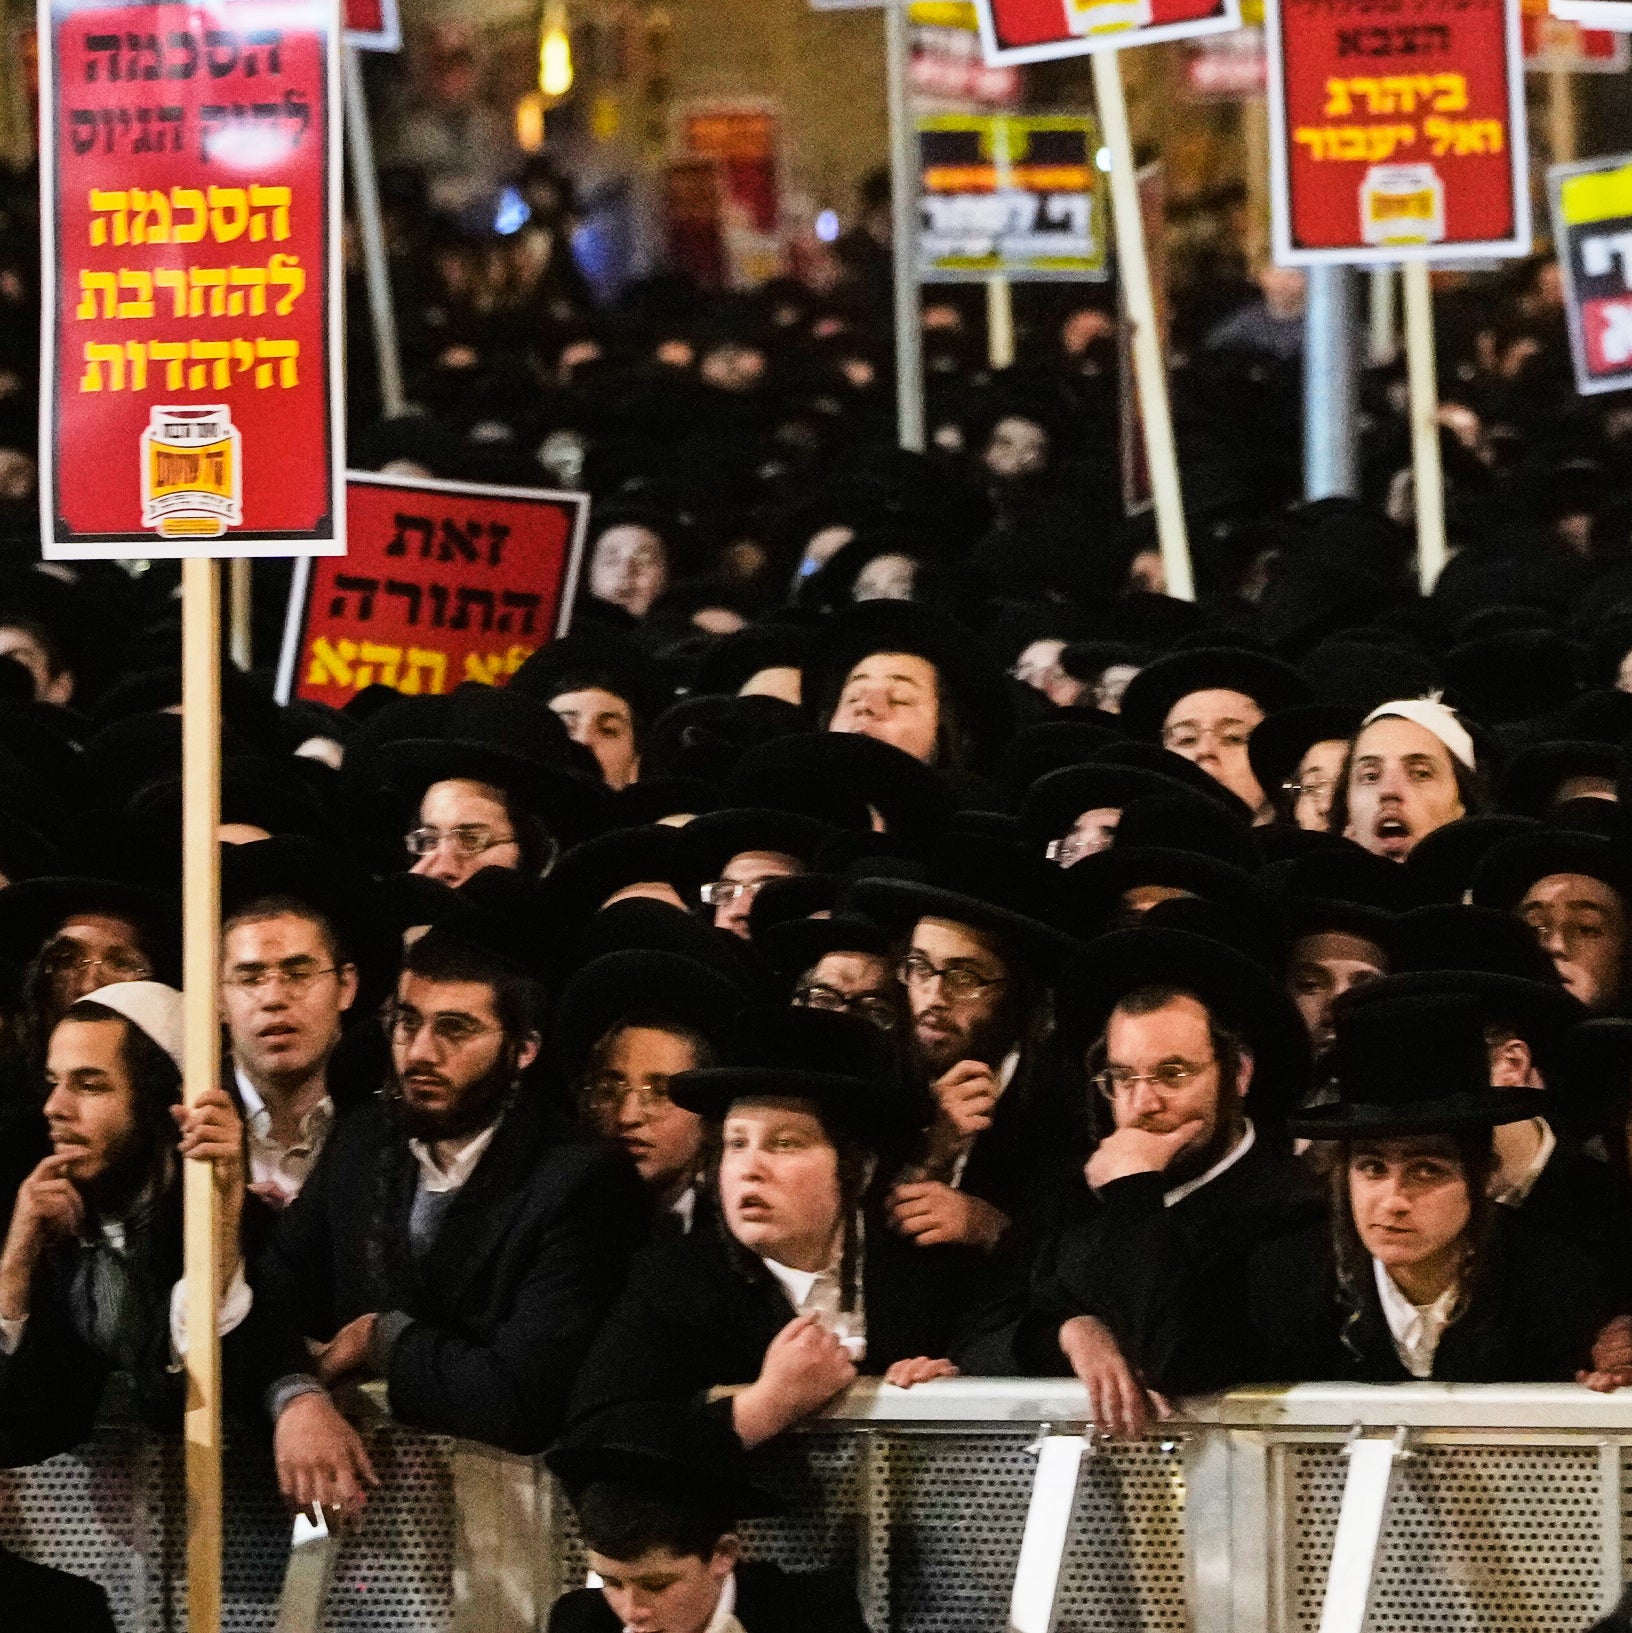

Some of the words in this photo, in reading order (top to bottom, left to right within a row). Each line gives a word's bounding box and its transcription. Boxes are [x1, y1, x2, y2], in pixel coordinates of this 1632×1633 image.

[85, 29, 282, 83] הסכמה
[1337, 23, 1451, 59] הצבא
[1325, 72, 1469, 118] ביהרג
[69, 105, 184, 156] הגיוס
[1293, 124, 1416, 162] יעבור
[1424, 117, 1502, 157] ואל
[89, 183, 292, 247] הסכמה
[76, 253, 306, 321] להחרבת
[80, 336, 300, 393] היהדות
[387, 513, 512, 567] זאת
[329, 574, 543, 635] התורה
[307, 636, 448, 695] תהא
